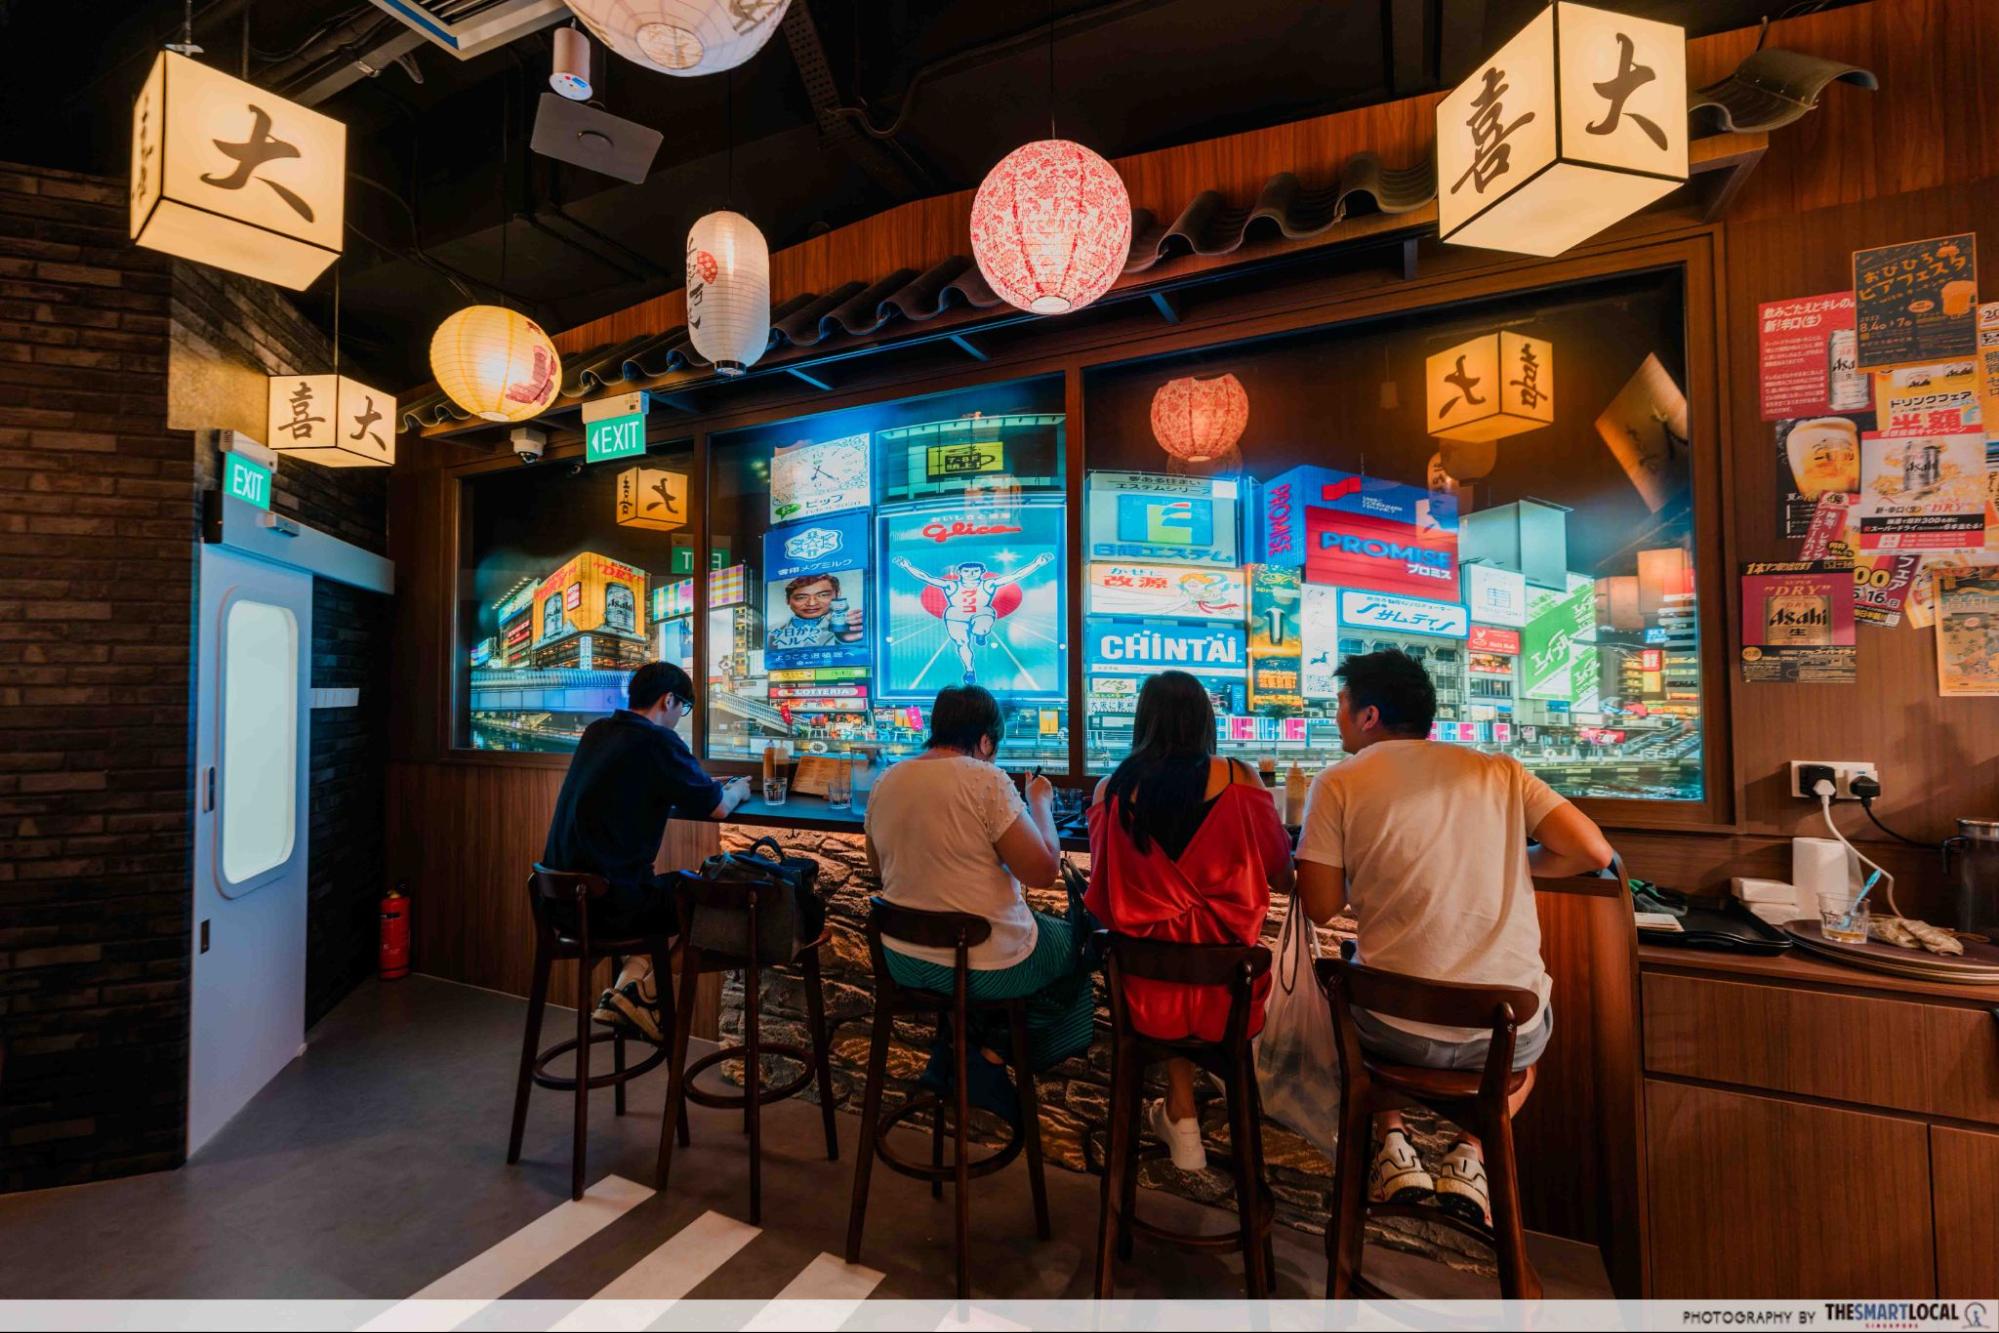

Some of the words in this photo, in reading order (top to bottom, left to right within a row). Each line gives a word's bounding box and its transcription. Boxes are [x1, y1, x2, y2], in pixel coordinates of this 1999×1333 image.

[1585, 32, 1668, 152] 大
[1450, 67, 1536, 195] 喜
[199, 103, 316, 224] 大
[1763, 298, 1855, 320] 飲みごたえとキレの
[1832, 357, 1855, 373] Asa
[278, 381, 326, 440] 喜
[349, 394, 387, 452] 大
[601, 420, 640, 454] EXIT
[233, 463, 264, 502] EXIT
[1320, 530, 1453, 569] PROMISE
[1406, 563, 1453, 580] プロミス
[1769, 607, 1827, 627] Asahi
